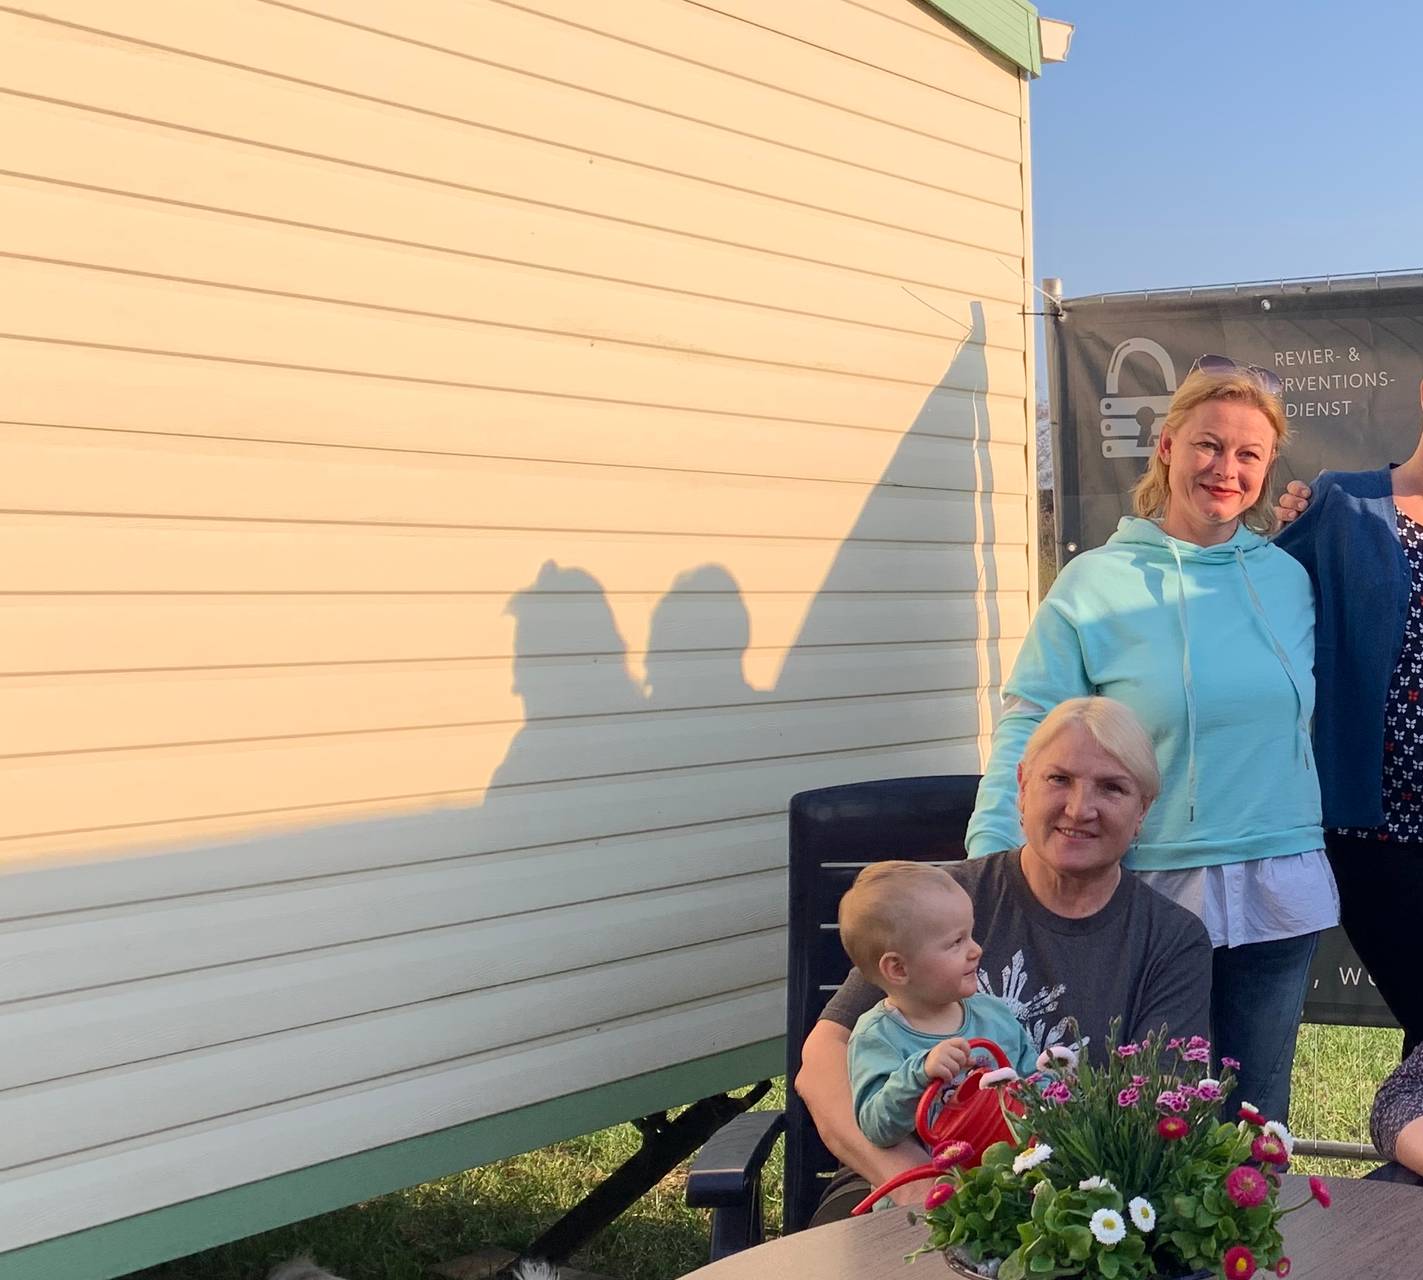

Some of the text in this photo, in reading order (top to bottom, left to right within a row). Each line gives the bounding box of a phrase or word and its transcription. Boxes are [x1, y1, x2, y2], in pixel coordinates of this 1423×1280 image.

[1274, 346, 1361, 367] REVIER- &
[1280, 371, 1396, 392] RVENTIONS-
[1285, 400, 1353, 418] DIENST
